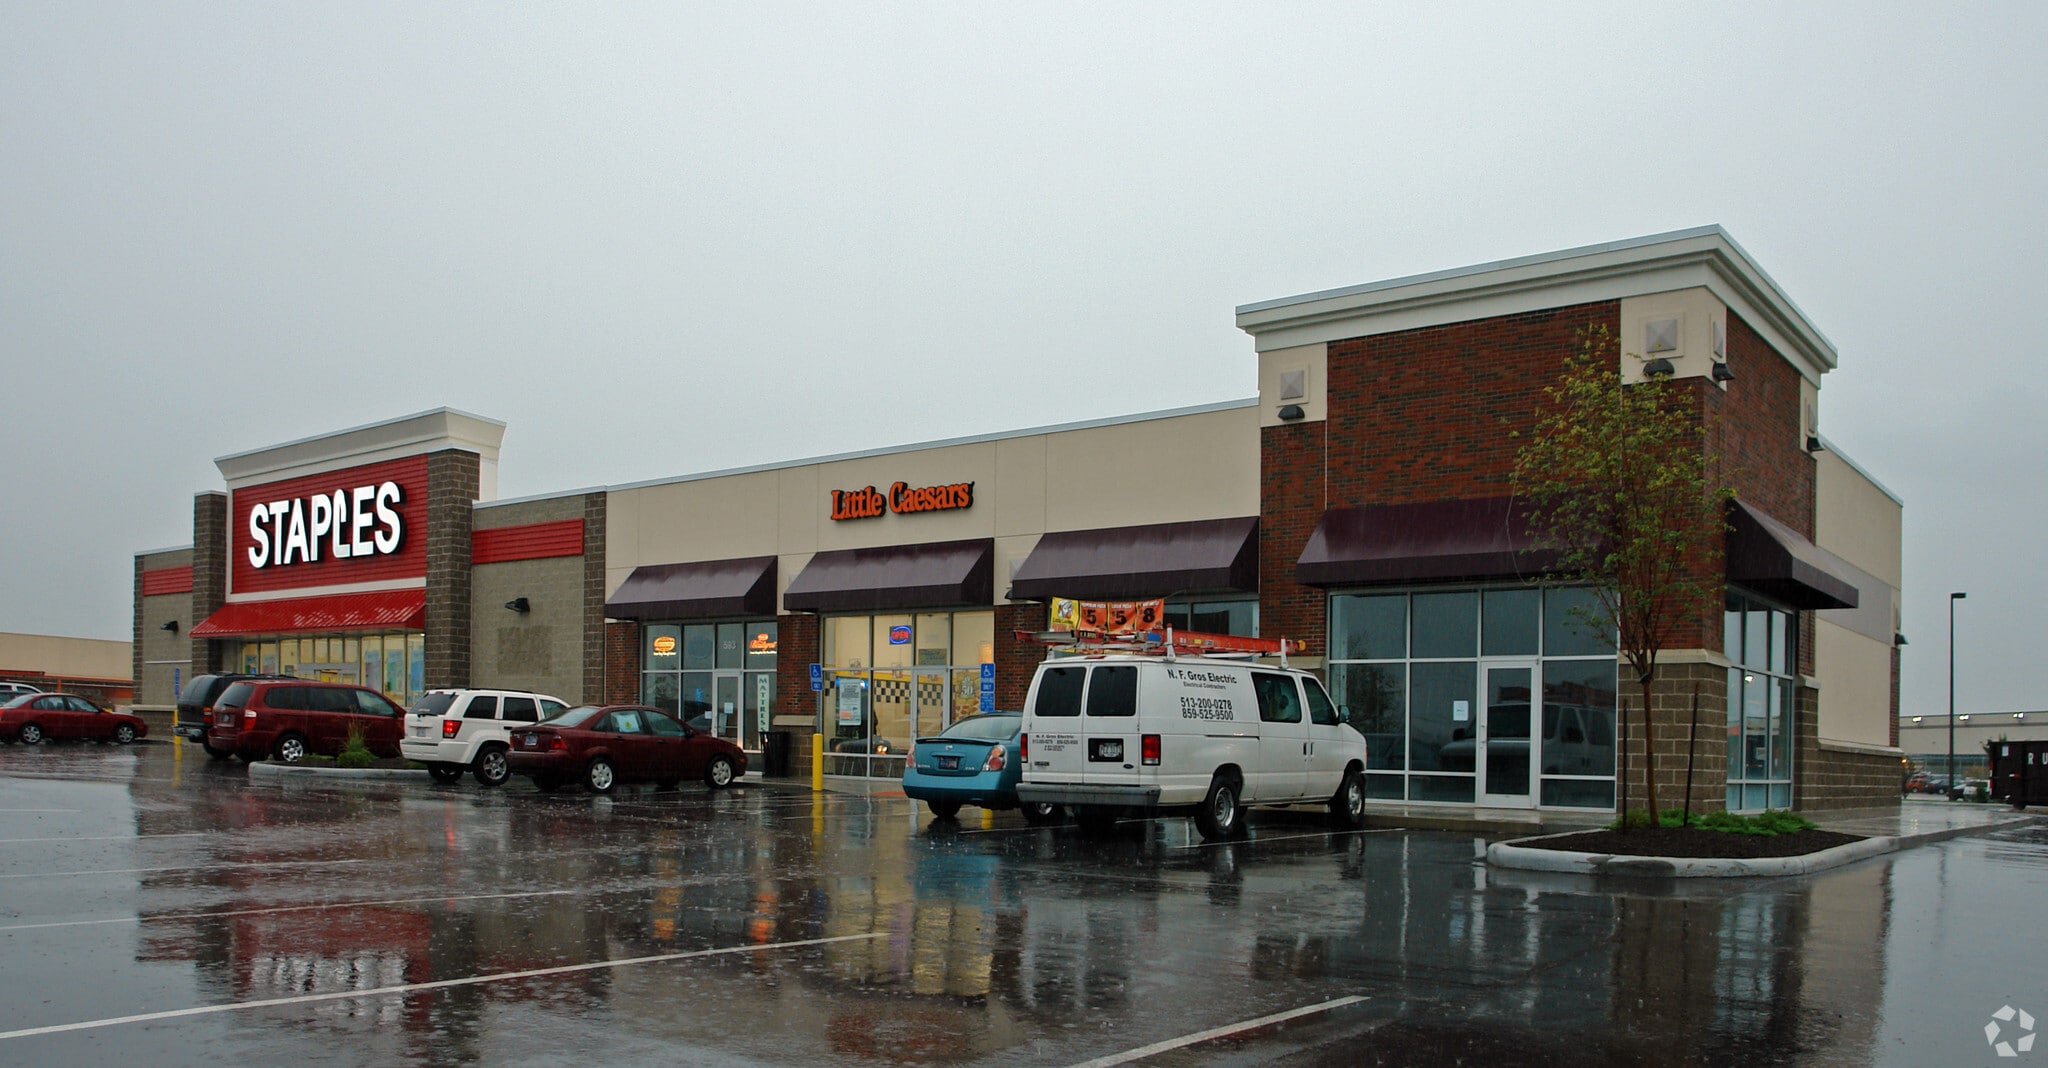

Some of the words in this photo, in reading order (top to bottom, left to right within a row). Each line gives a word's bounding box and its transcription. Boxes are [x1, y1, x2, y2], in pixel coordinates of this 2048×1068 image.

[831, 486, 884, 520] Little
[889, 481, 972, 514] Caesars
[248, 481, 401, 569] STAPLES
[891, 630, 909, 640] OPEN
[1167, 669, 1178, 679] N.
[1178, 670, 1186, 680] F.
[1187, 671, 1207, 682] Gros
[1207, 672, 1237, 684] Electric
[1180, 696, 1233, 711] 513-200-0278
[1181, 707, 1234, 721] 859-525-9500
